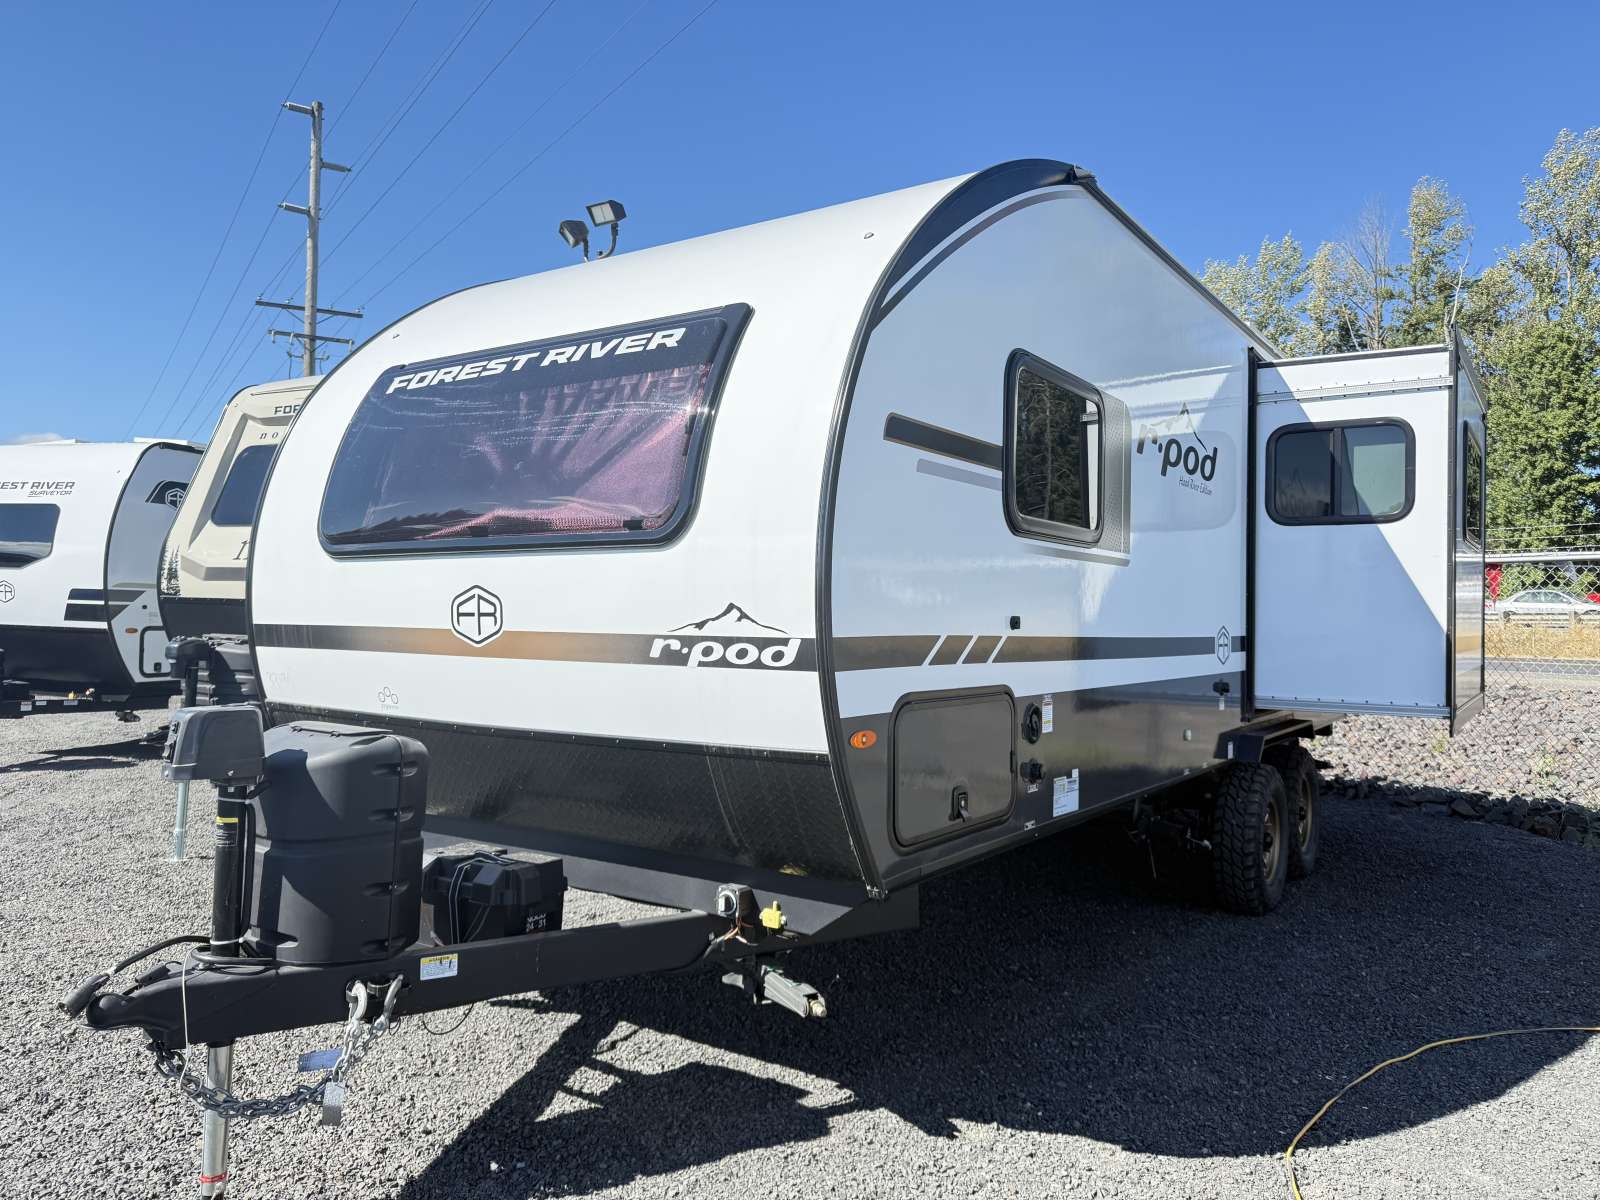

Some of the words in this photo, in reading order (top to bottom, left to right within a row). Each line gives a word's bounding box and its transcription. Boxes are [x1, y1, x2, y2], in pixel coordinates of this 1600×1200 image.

[385, 353, 541, 395] FOREST
[540, 328, 687, 366] RIVER
[0, 481, 29, 490] EST
[30, 481, 76, 490] RIVER
